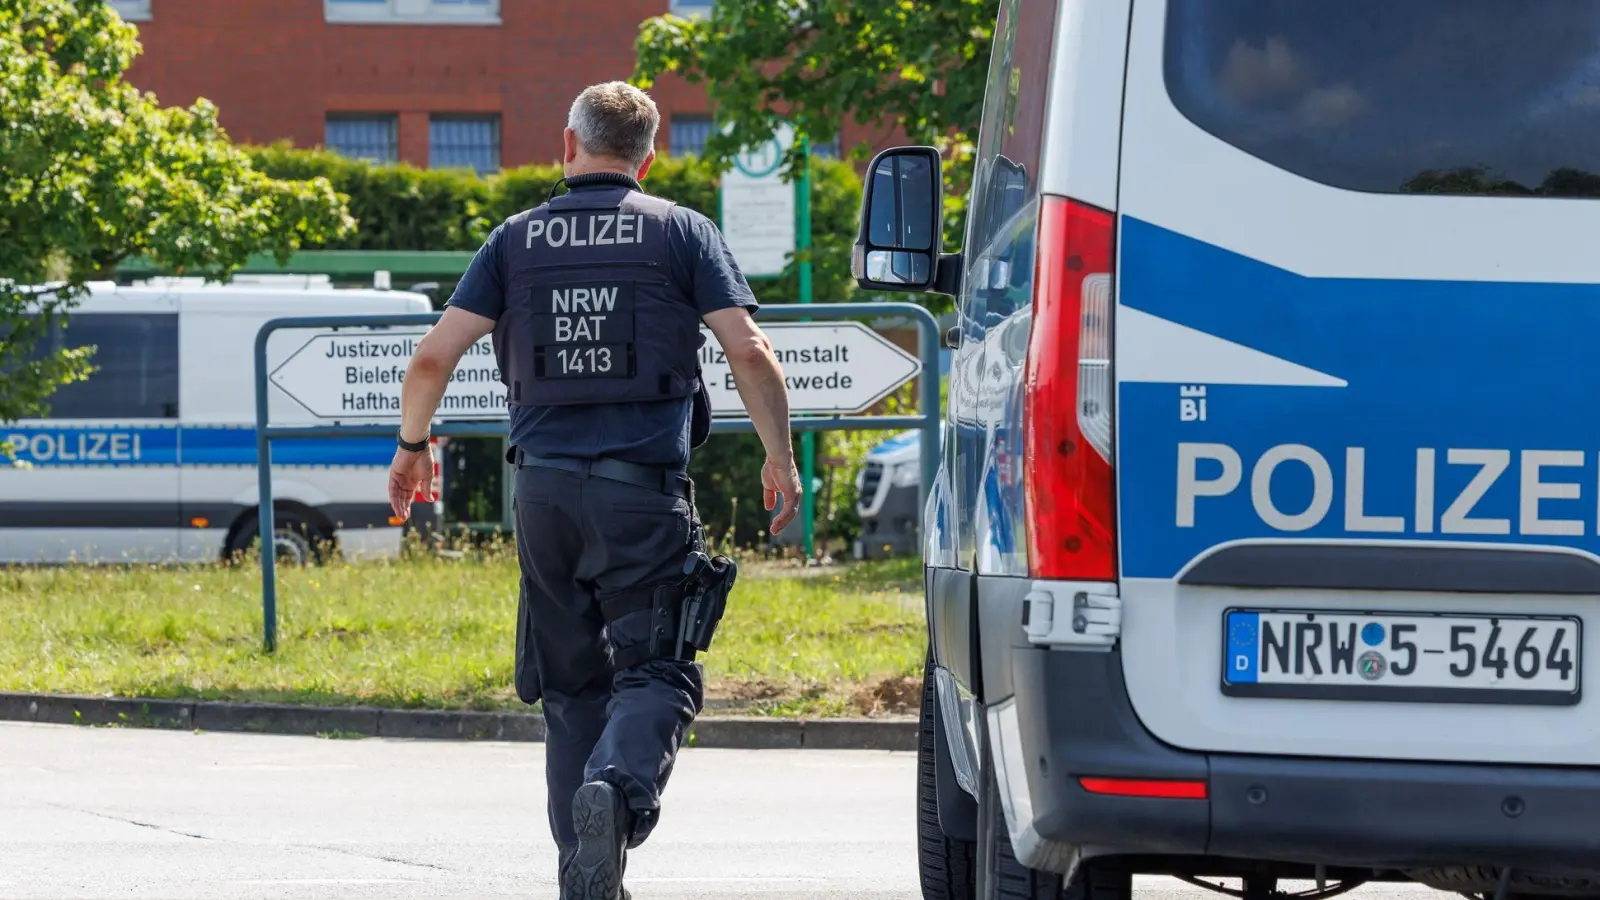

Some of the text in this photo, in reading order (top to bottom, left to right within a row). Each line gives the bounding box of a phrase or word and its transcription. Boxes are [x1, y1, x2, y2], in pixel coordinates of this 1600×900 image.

[526, 215, 643, 248] POLIZEI
[552, 287, 618, 313] NRW
[555, 316, 606, 341] BAT
[557, 347, 611, 374] 1413
[346, 366, 406, 384] Bielefe
[725, 372, 852, 390] Bwede
[342, 390, 506, 410] Haftha mmeln
[8, 433, 141, 461] POLIZEI
[1176, 442, 1600, 536] POLIZE
[1235, 655, 1249, 671] D
[1261, 621, 1573, 680] NRW 5-5464
